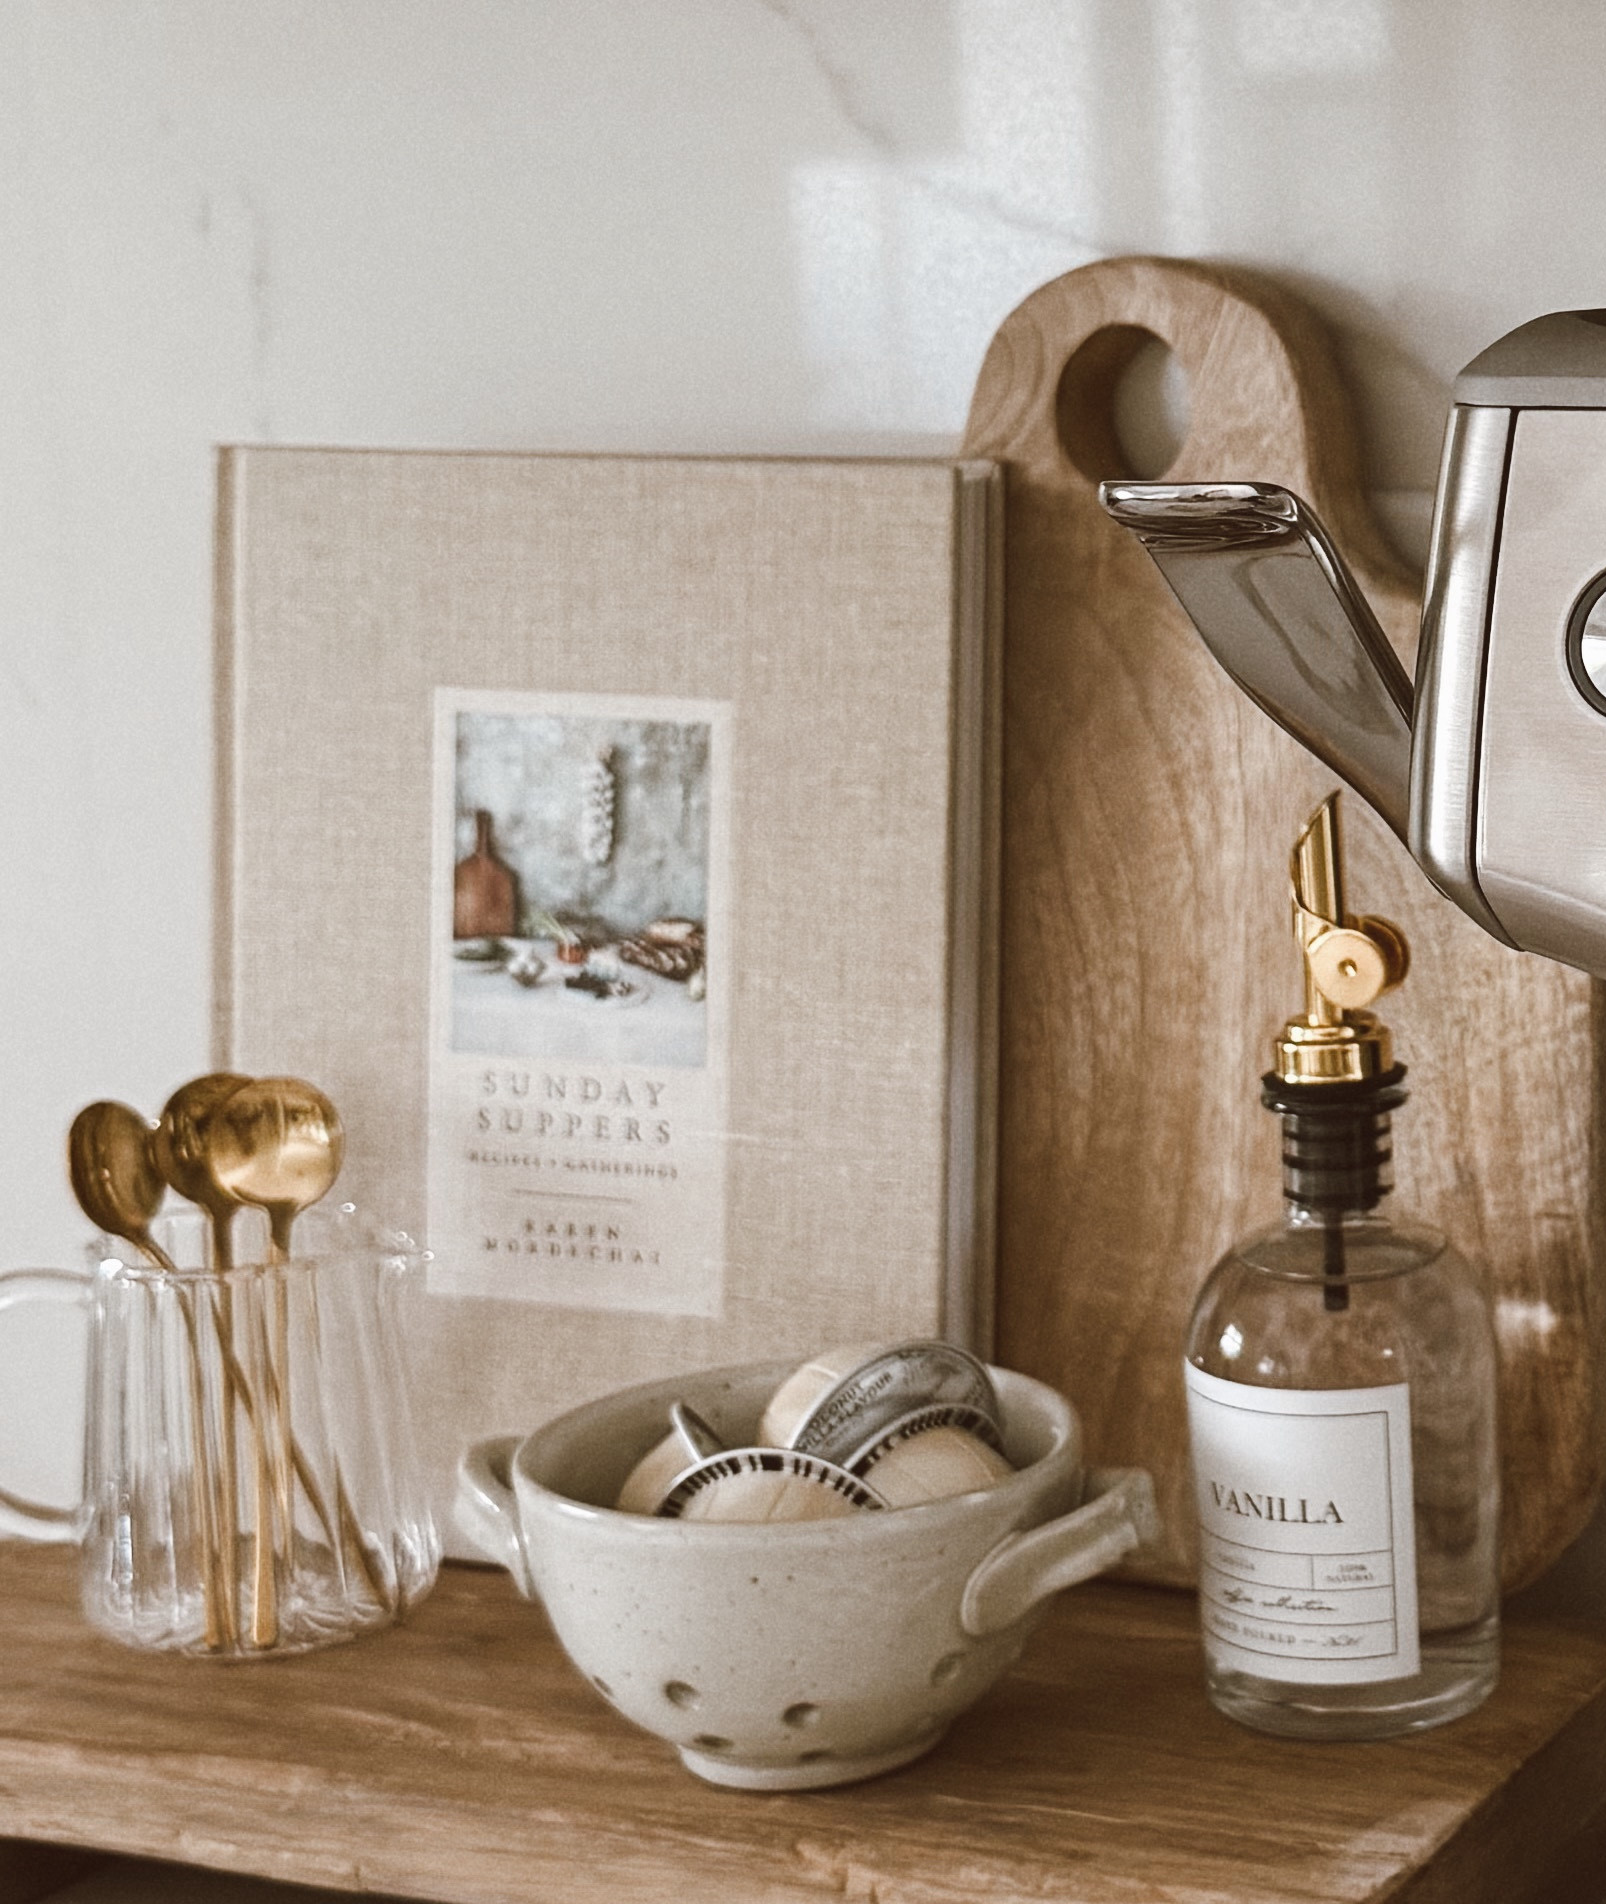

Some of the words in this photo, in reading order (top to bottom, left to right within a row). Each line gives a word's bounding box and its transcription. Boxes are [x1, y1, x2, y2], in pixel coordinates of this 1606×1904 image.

[483, 1072, 665, 1106] SUNDAY
[478, 1108, 670, 1143] SUPPERS
[1210, 1480, 1344, 1524] VANILLA
